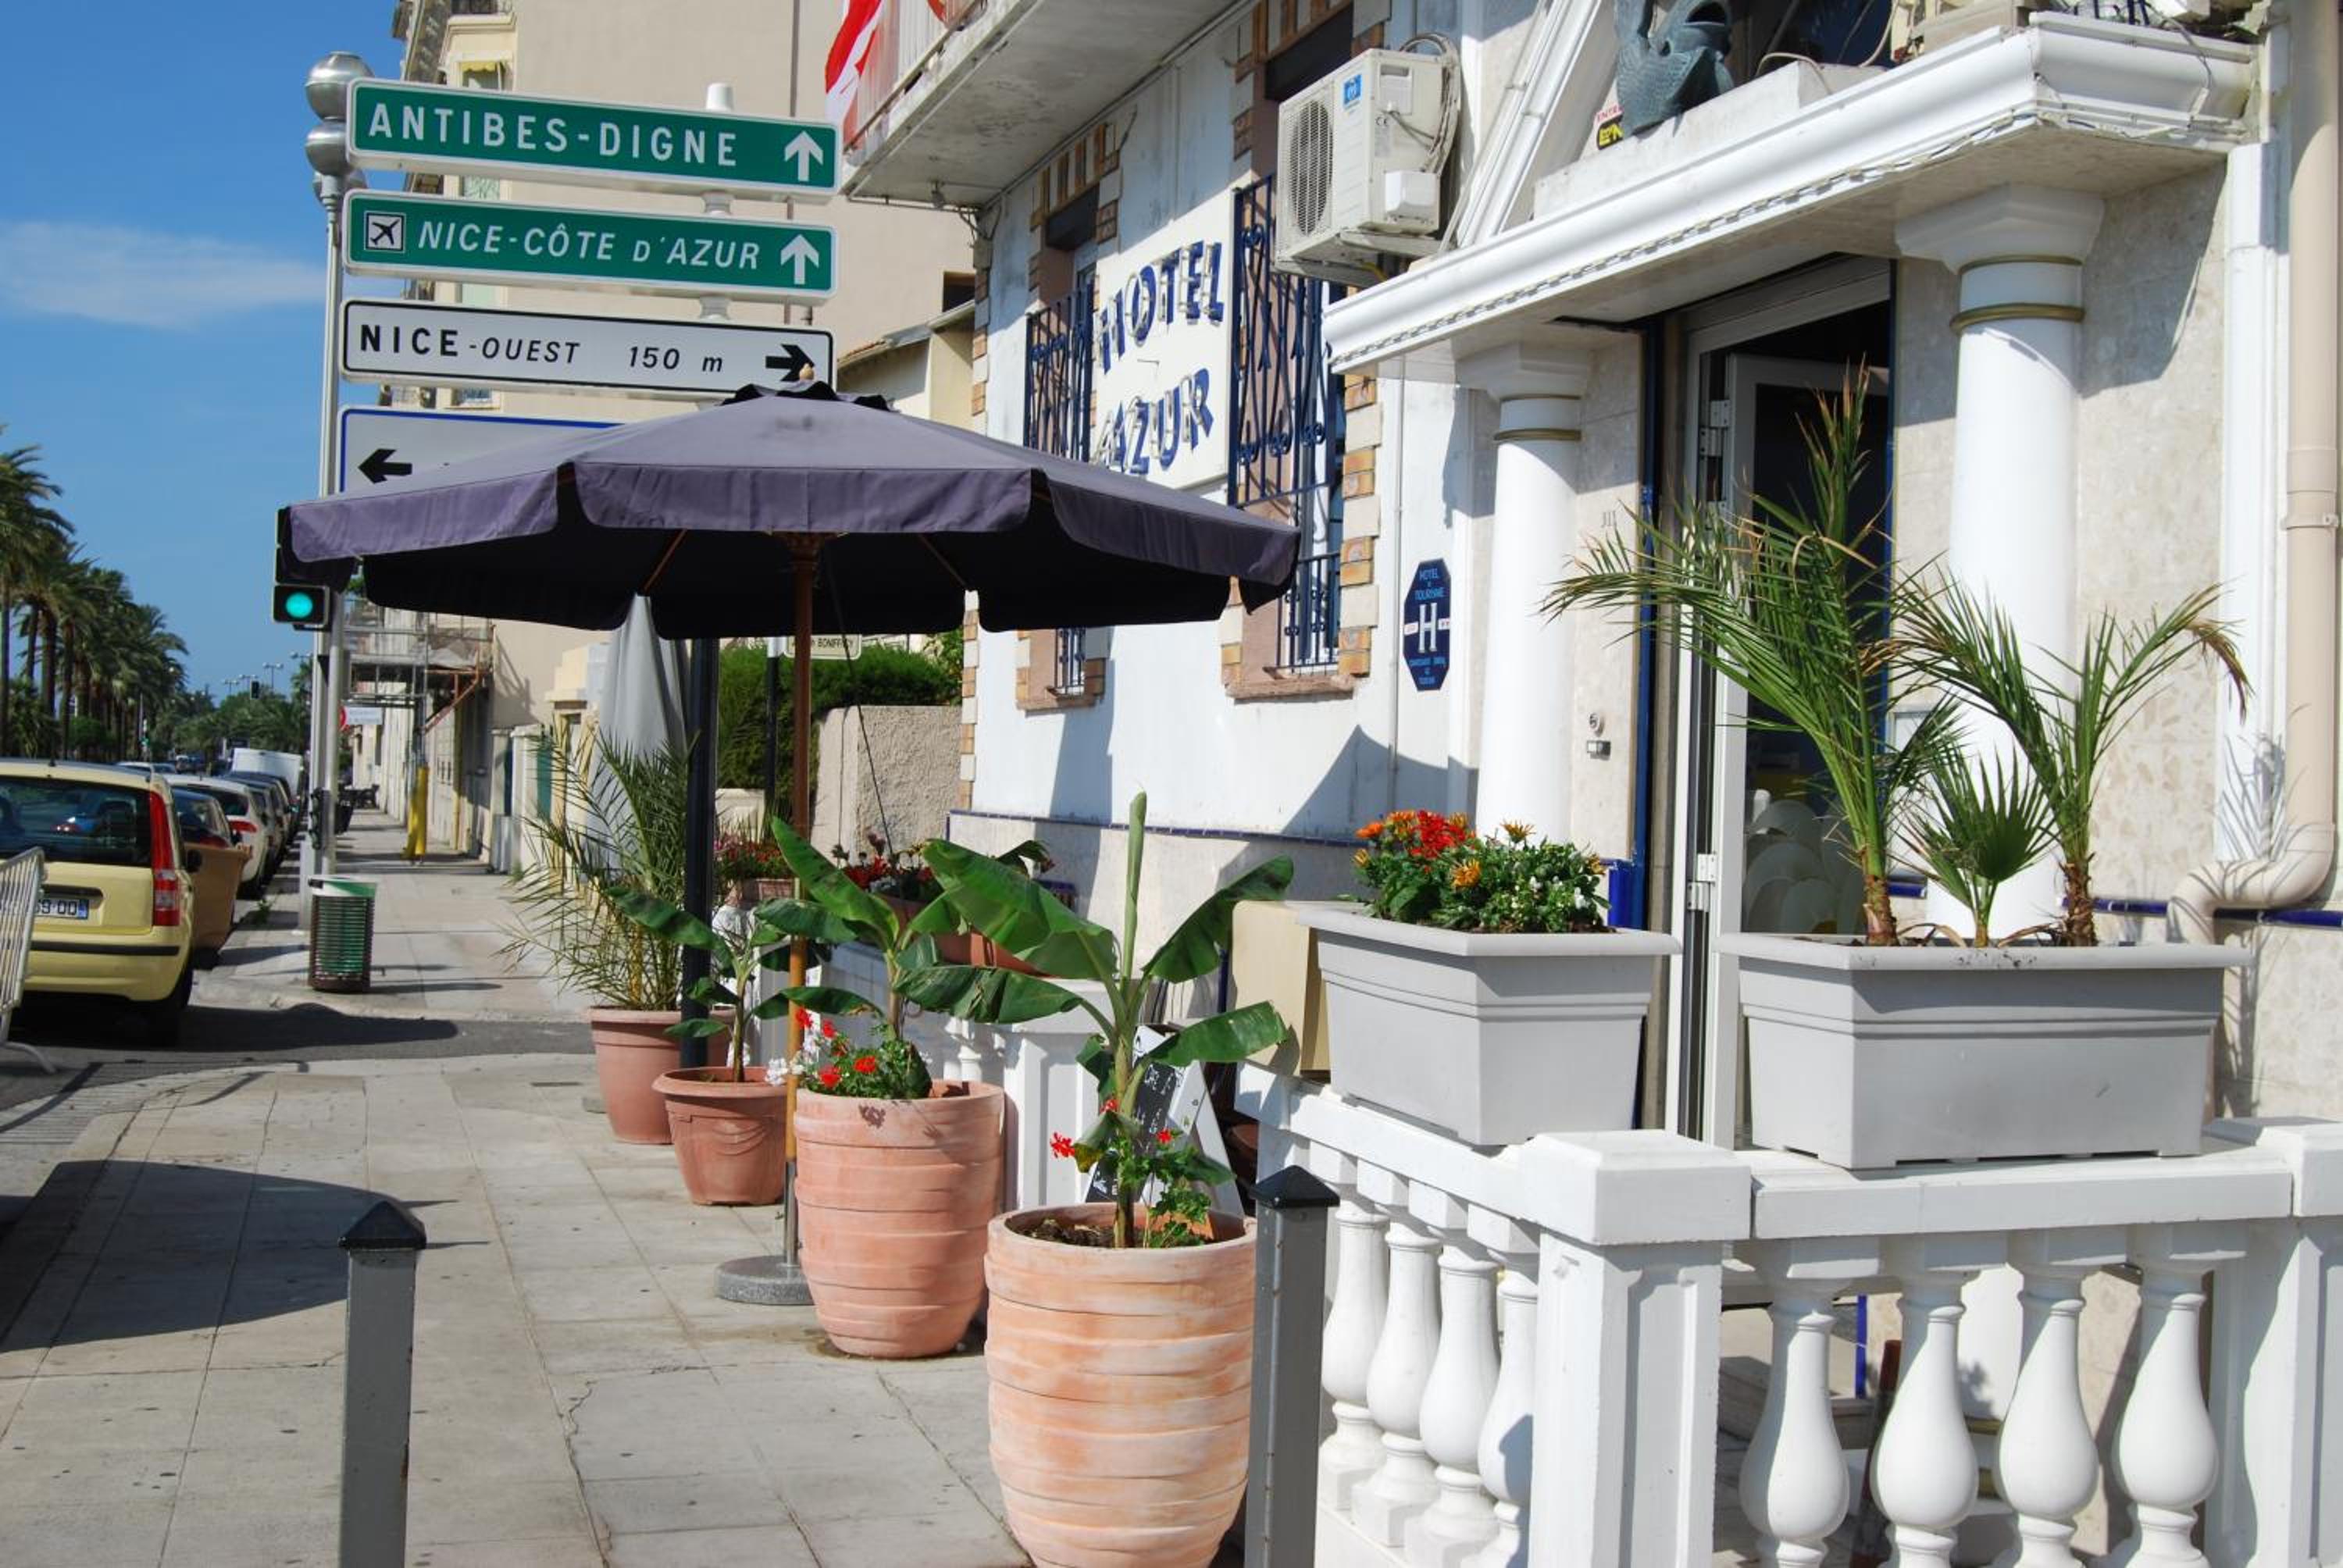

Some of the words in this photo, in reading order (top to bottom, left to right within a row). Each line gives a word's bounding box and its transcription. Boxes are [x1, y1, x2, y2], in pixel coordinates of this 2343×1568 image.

[369, 102, 737, 167] ANTIBES-DIGNE
[418, 220, 615, 261] NICE-CÔTE
[1095, 240, 1225, 375] HOTEL
[628, 344, 680, 371] 150
[701, 354, 723, 373] m
[1093, 368, 1215, 475] AZUR
[1418, 602, 1437, 654] H
